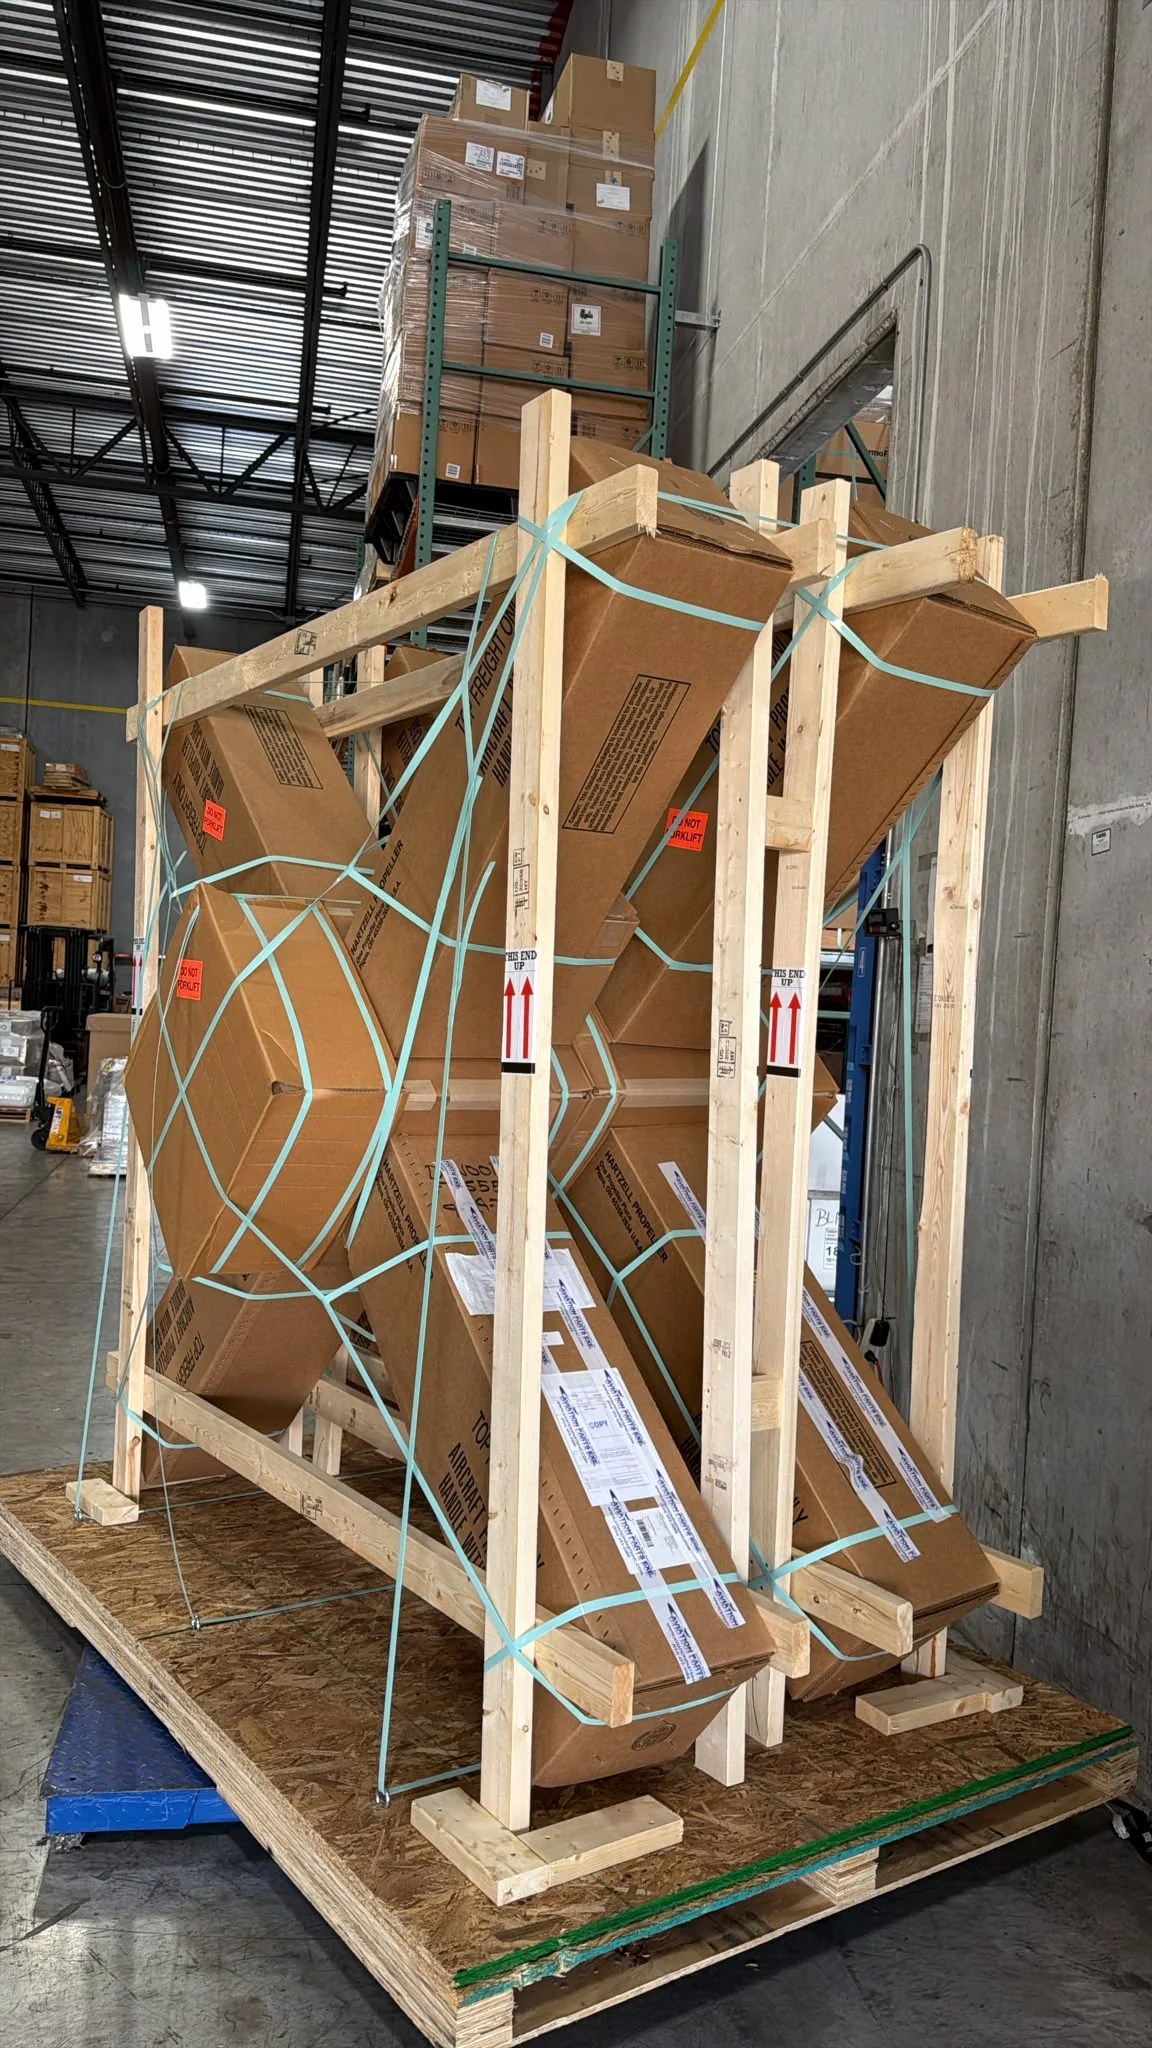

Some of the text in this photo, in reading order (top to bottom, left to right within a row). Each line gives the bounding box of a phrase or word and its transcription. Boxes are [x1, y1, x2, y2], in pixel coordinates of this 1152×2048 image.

[470, 629, 506, 706] FREIGHT
[596, 742, 613, 766] Packaging
[685, 818, 701, 829] NOT
[666, 829, 703, 843] ORKLIFT
[351, 905, 375, 956] HARTZELL
[374, 840, 404, 903] POPELLER
[514, 962, 525, 970] UP
[521, 950, 537, 960] END
[181, 966, 198, 977] DO NOT
[788, 970, 805, 978] END
[178, 980, 200, 992] FORKLIFT
[605, 1150, 633, 1202] HARTZELL
[383, 1159, 406, 1216] HARTZELL
[606, 1186, 613, 1198] OH
[621, 1201, 633, 1221] Place
[589, 1420, 608, 1429] COPY
[448, 1442, 487, 1524] AIRCRAFT
[438, 1472, 468, 1536] HANDLE
[609, 1500, 633, 1536] AVIATION
[627, 1534, 645, 1561] PARTS
[712, 1589, 742, 1627] AVIATION
[667, 1614, 694, 1653] AVIATION
